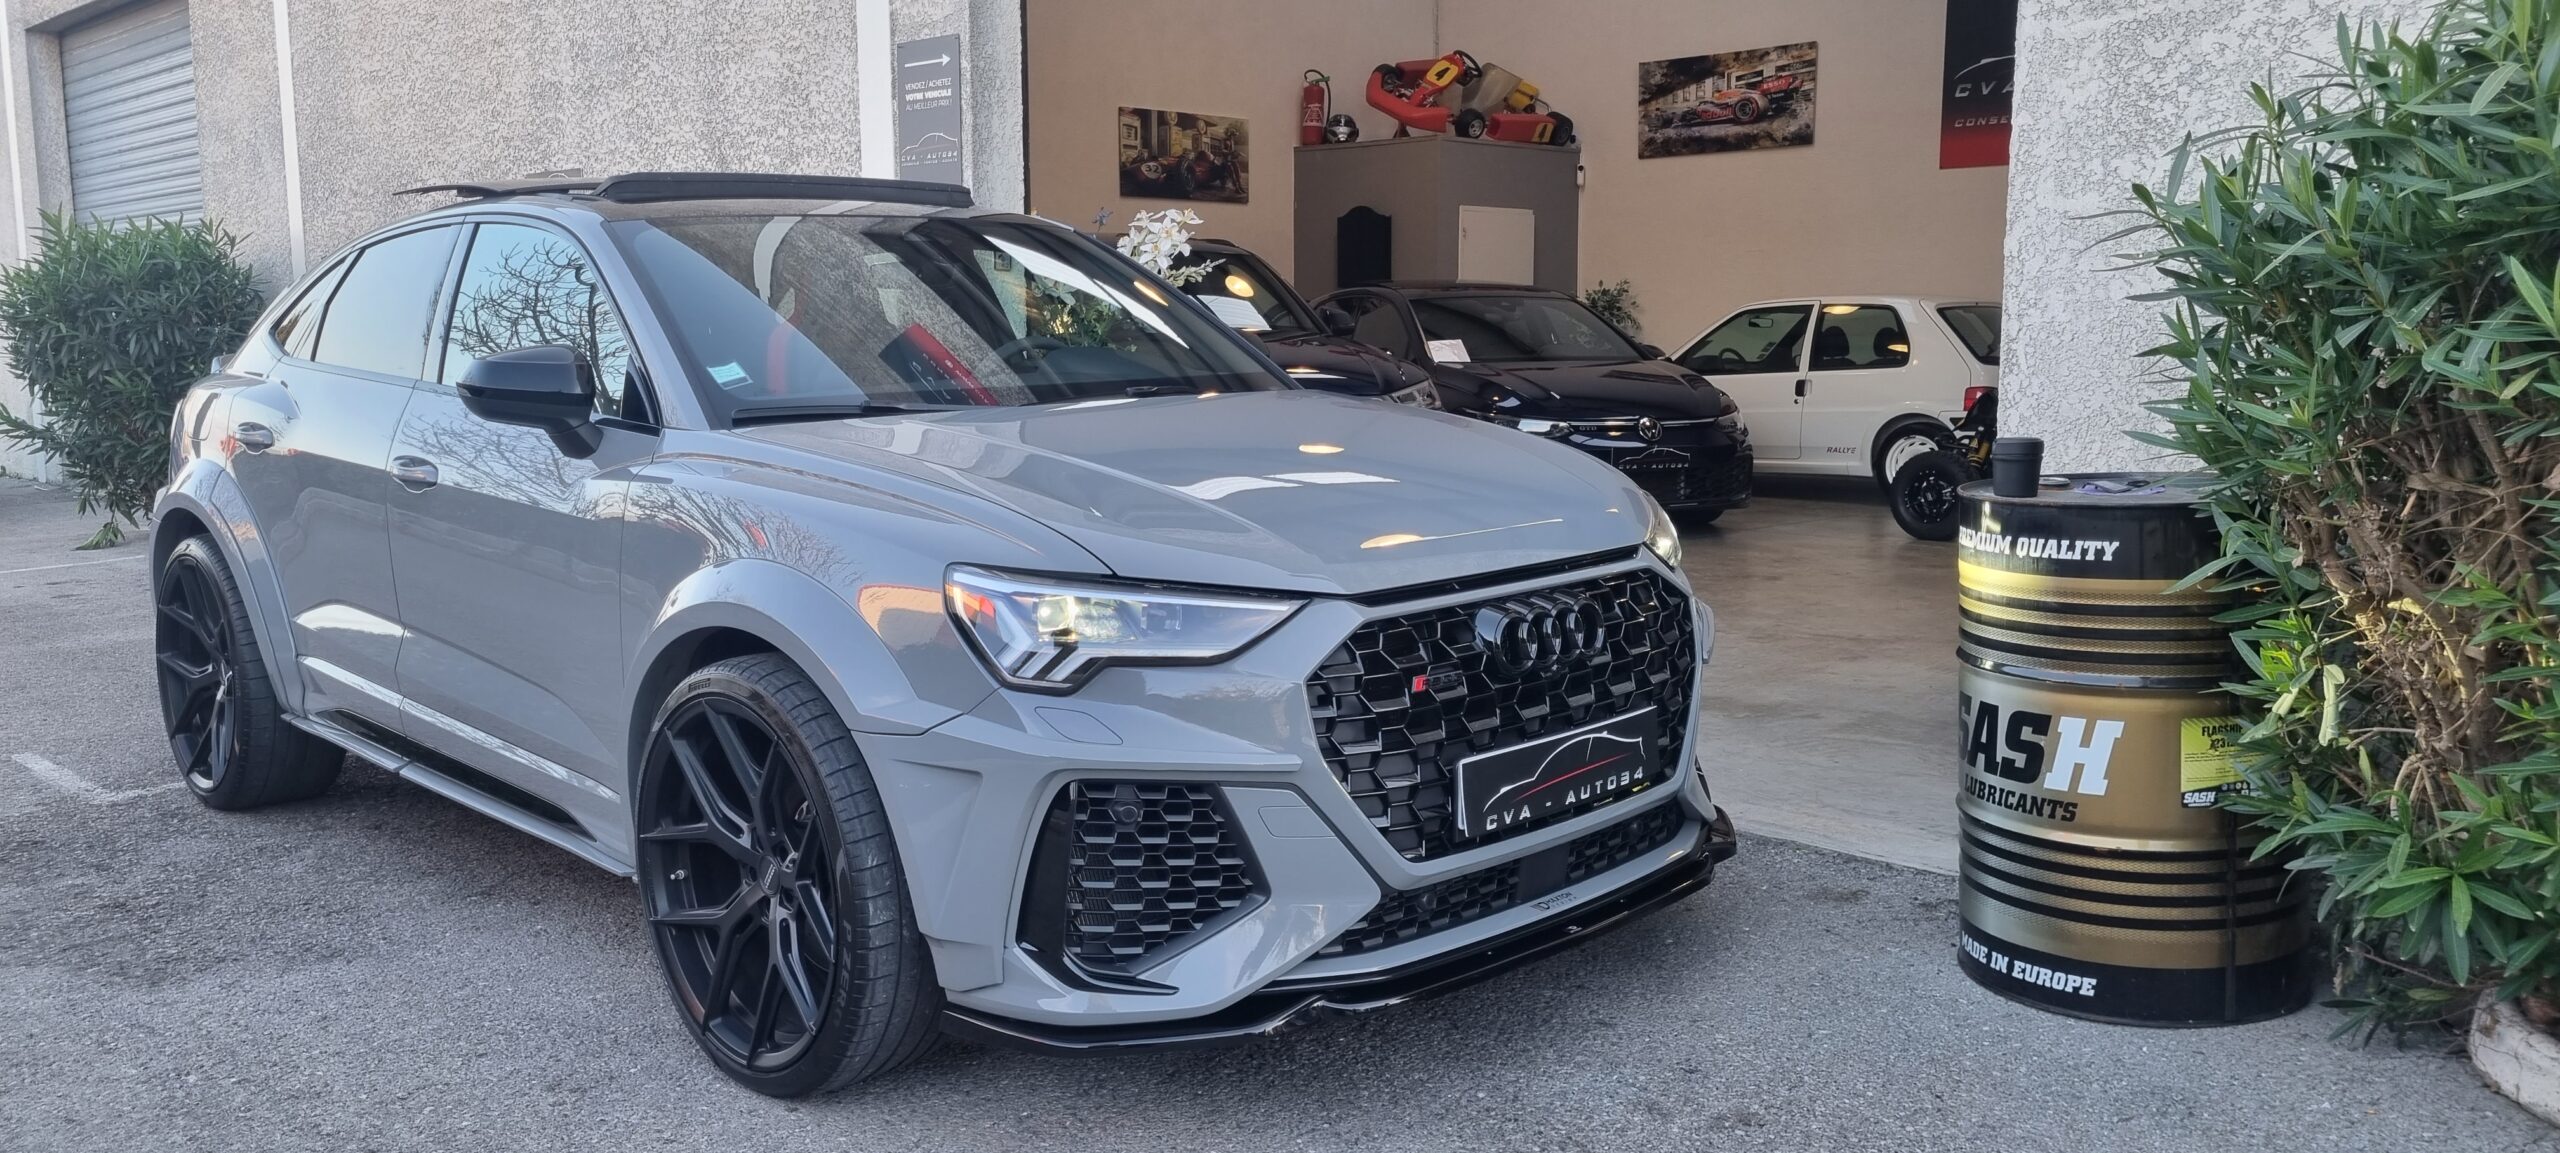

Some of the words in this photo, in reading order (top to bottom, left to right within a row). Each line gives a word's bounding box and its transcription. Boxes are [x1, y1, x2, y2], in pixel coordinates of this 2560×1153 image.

[1144, 164, 1160, 174] 32
[1826, 446, 1857, 454] RALLYE
[2016, 537, 2119, 561] QUALITY
[1486, 804, 1531, 831] CVA
[1565, 766, 1644, 805] AUTO34
[1965, 774, 2078, 822] LUBRICANTS
[2183, 791, 2216, 804] SASH
[1961, 930, 1988, 964] MADE
[1990, 951, 2009, 974] IN
[2012, 960, 2097, 996] EUROPE
